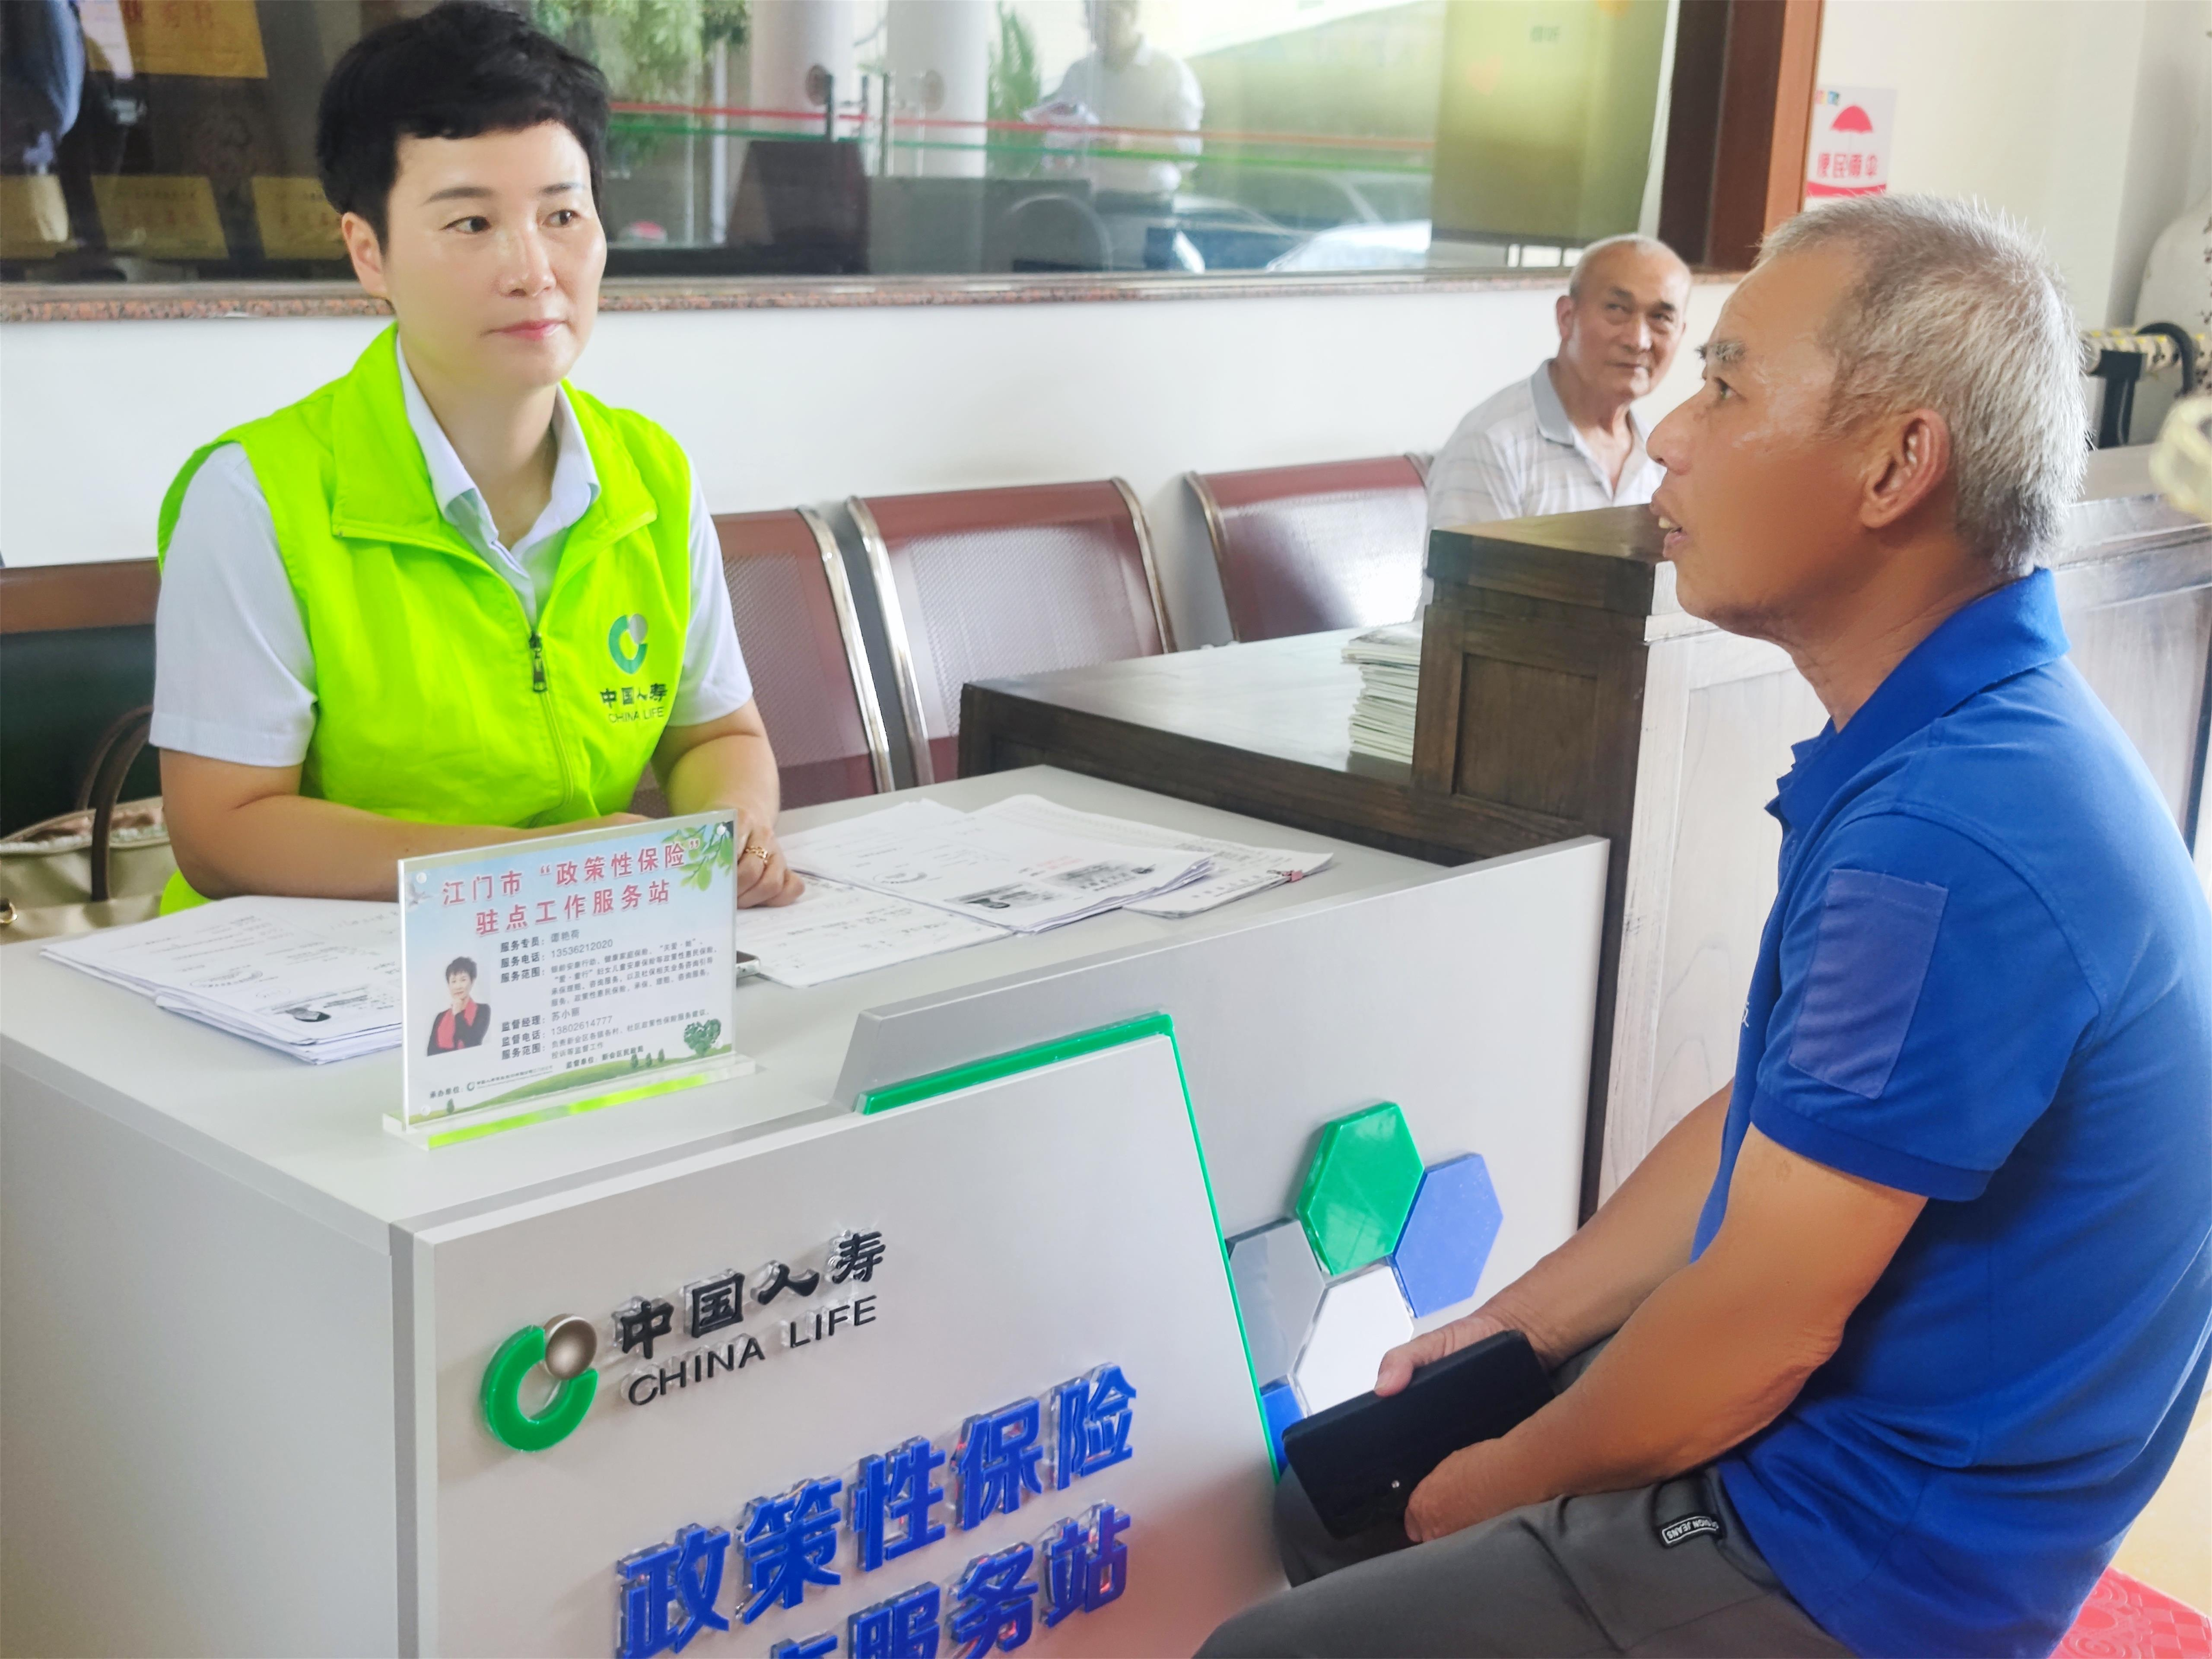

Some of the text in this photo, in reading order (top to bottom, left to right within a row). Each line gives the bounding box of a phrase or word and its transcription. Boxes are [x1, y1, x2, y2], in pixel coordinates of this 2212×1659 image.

[600, 683, 668, 709] 中国人寿
[608, 707, 664, 723] CHINA LIFE
[476, 879, 670, 937] 驻点工作服务站
[551, 939, 613, 958] 13536212020
[551, 1015, 613, 1036] 13802614777
[618, 1229, 886, 1360] 中国人寿
[628, 1295, 877, 1405] CHINA LIFE
[618, 1362, 1137, 1659] 政策性保险
